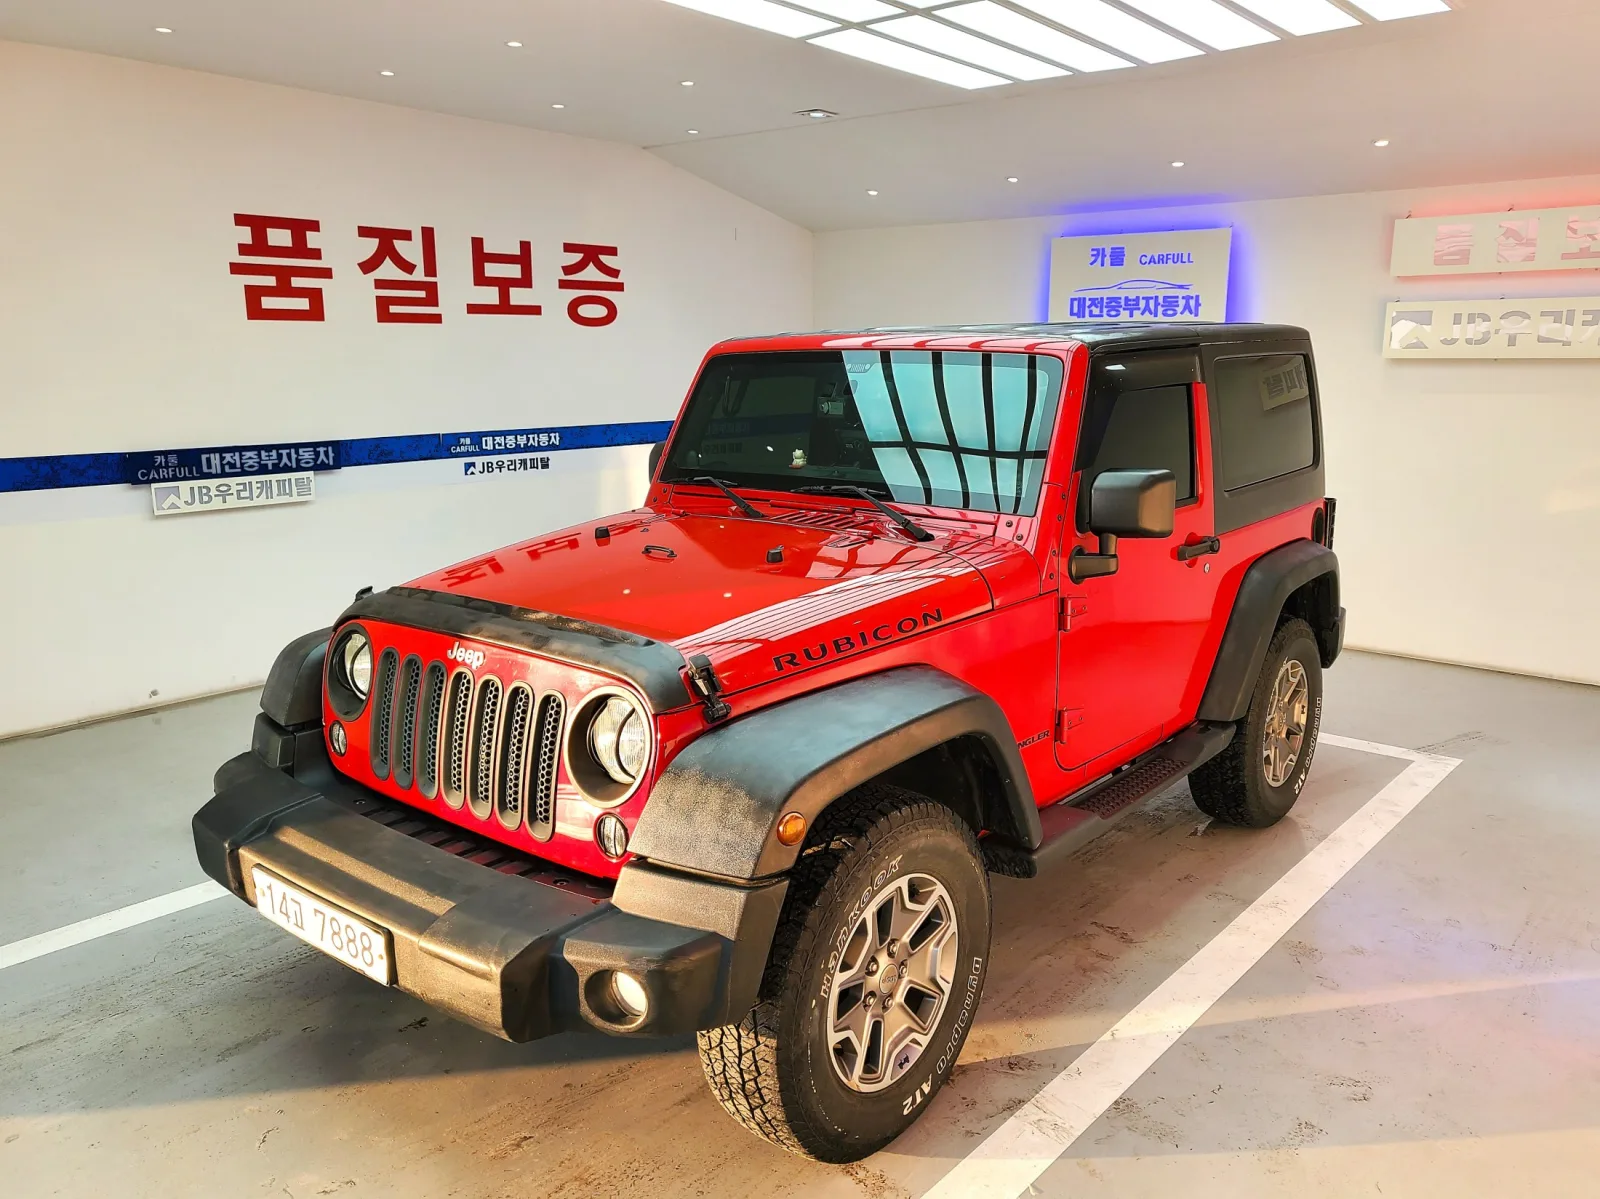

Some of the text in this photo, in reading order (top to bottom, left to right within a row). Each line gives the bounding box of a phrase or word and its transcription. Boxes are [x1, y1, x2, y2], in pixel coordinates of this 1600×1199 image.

[229, 213, 625, 327] 품질보증
[1089, 246, 1194, 267] 카풀 CARFULL
[1069, 294, 1202, 319] 대전중부자동차
[450, 445, 480, 453] CARFULL
[482, 432, 560, 450] 대전중부자동차
[137, 466, 200, 481] CARFULL
[201, 446, 335, 475] 대전중부자동차
[478, 456, 550, 474] JB우리캐피탈
[183, 476, 313, 507] JB우리캐피탈
[772, 607, 943, 672] RUBICON
[447, 641, 485, 670] Jeep
[313, 907, 374, 968] 7888
[902, 1073, 933, 1116] AT2
